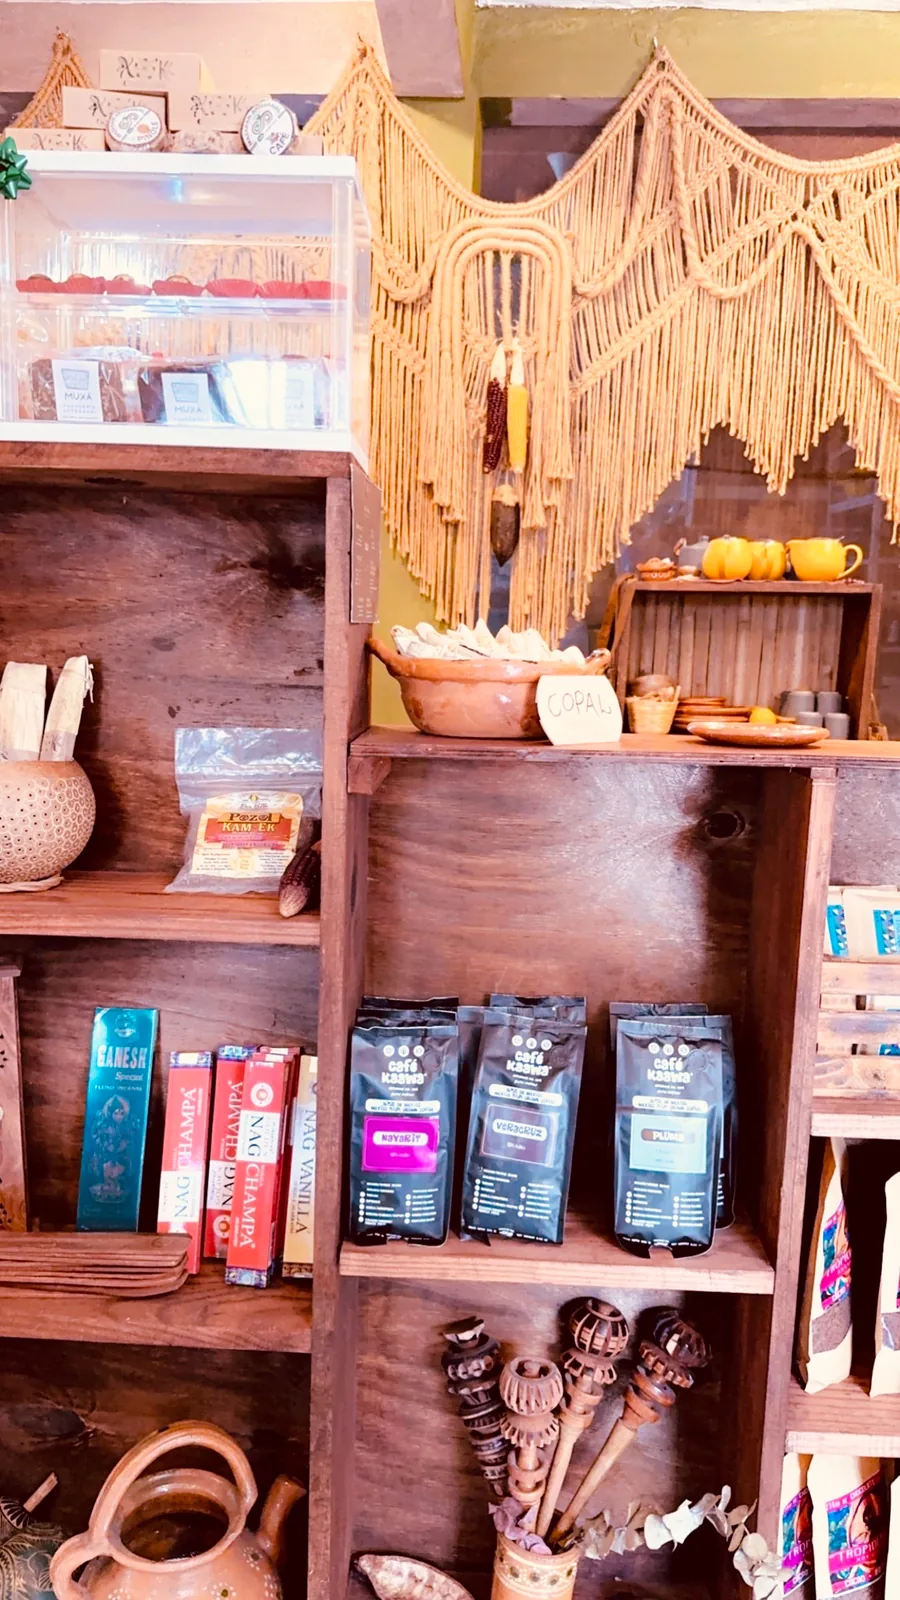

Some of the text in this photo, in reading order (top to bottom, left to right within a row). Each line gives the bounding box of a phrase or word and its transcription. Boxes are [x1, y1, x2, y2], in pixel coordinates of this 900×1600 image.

[64, 391, 93, 401] MUXA
[174, 405, 202, 414] MUXA
[548, 690, 612, 718] COPAL
[222, 822, 252, 832] KAM
[228, 812, 273, 822] Pozol
[97, 1044, 148, 1069] GANESH
[224, 1081, 244, 1161] CHAMPA
[248, 1115, 264, 1157] NAG
[296, 1109, 317, 1234] NAG VANILLA
[174, 1176, 191, 1218] NAG
[240, 1163, 260, 1248] CHAMPA
